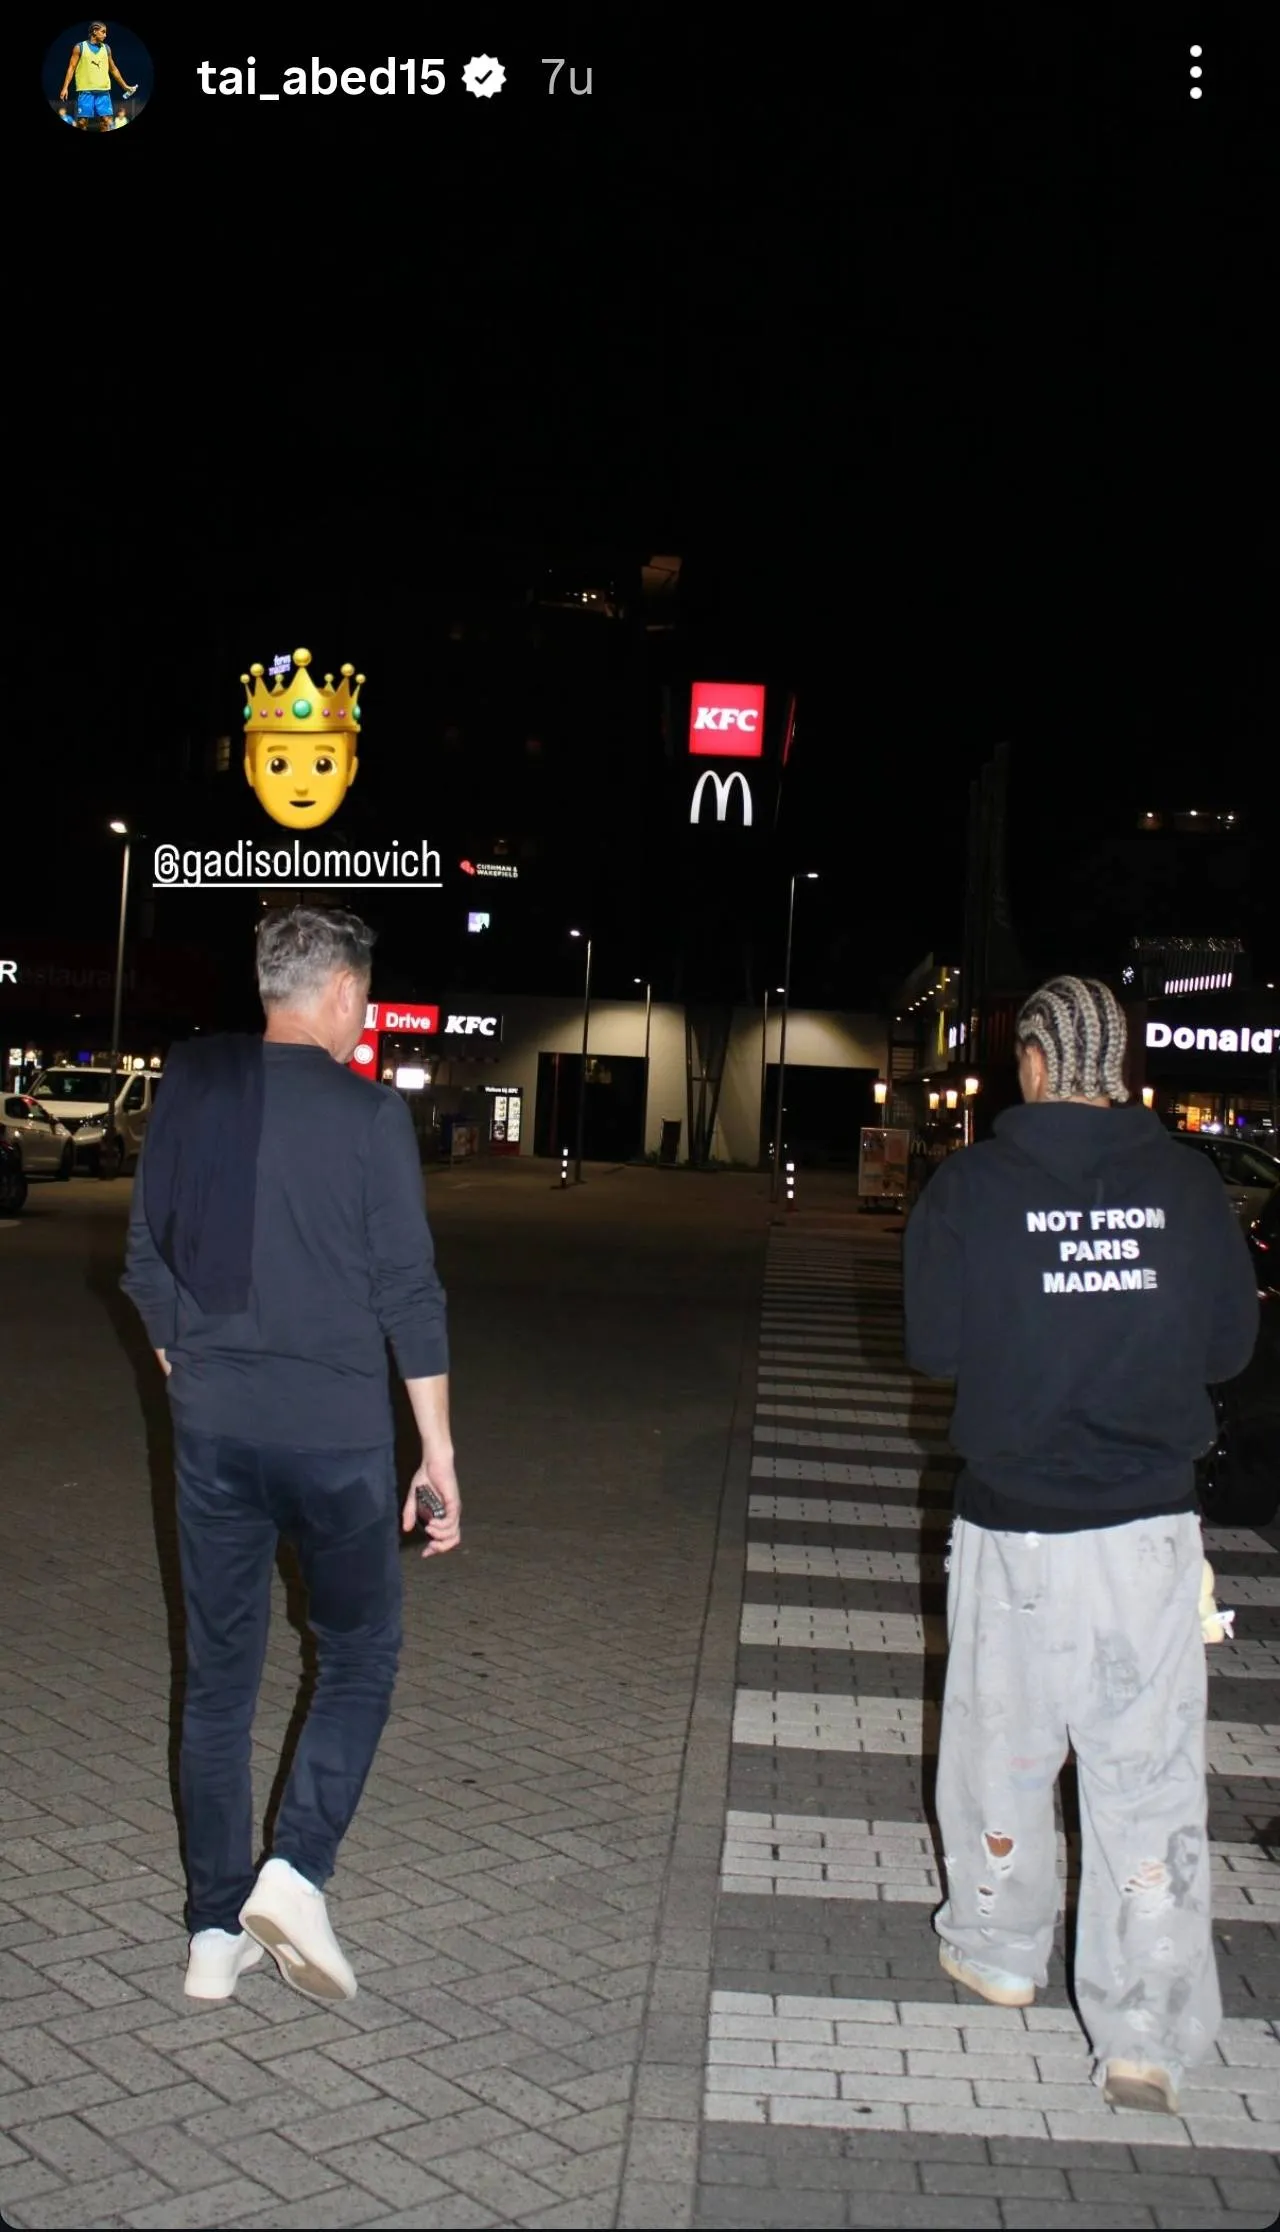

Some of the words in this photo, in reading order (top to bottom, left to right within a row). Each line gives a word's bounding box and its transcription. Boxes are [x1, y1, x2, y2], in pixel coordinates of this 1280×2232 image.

[694, 707, 759, 732] KFC
[476, 863, 512, 872] CUSHMAN
[476, 869, 519, 878] WAKEFIELD
[386, 1012, 431, 1030] Drive
[445, 1015, 497, 1036] KFC
[1145, 1022, 1280, 1053] Donald'
[1026, 1210, 1083, 1232] NOT
[1090, 1208, 1165, 1231] FROM
[1059, 1239, 1140, 1262] PARIS
[1042, 1268, 1158, 1293] MADAME
